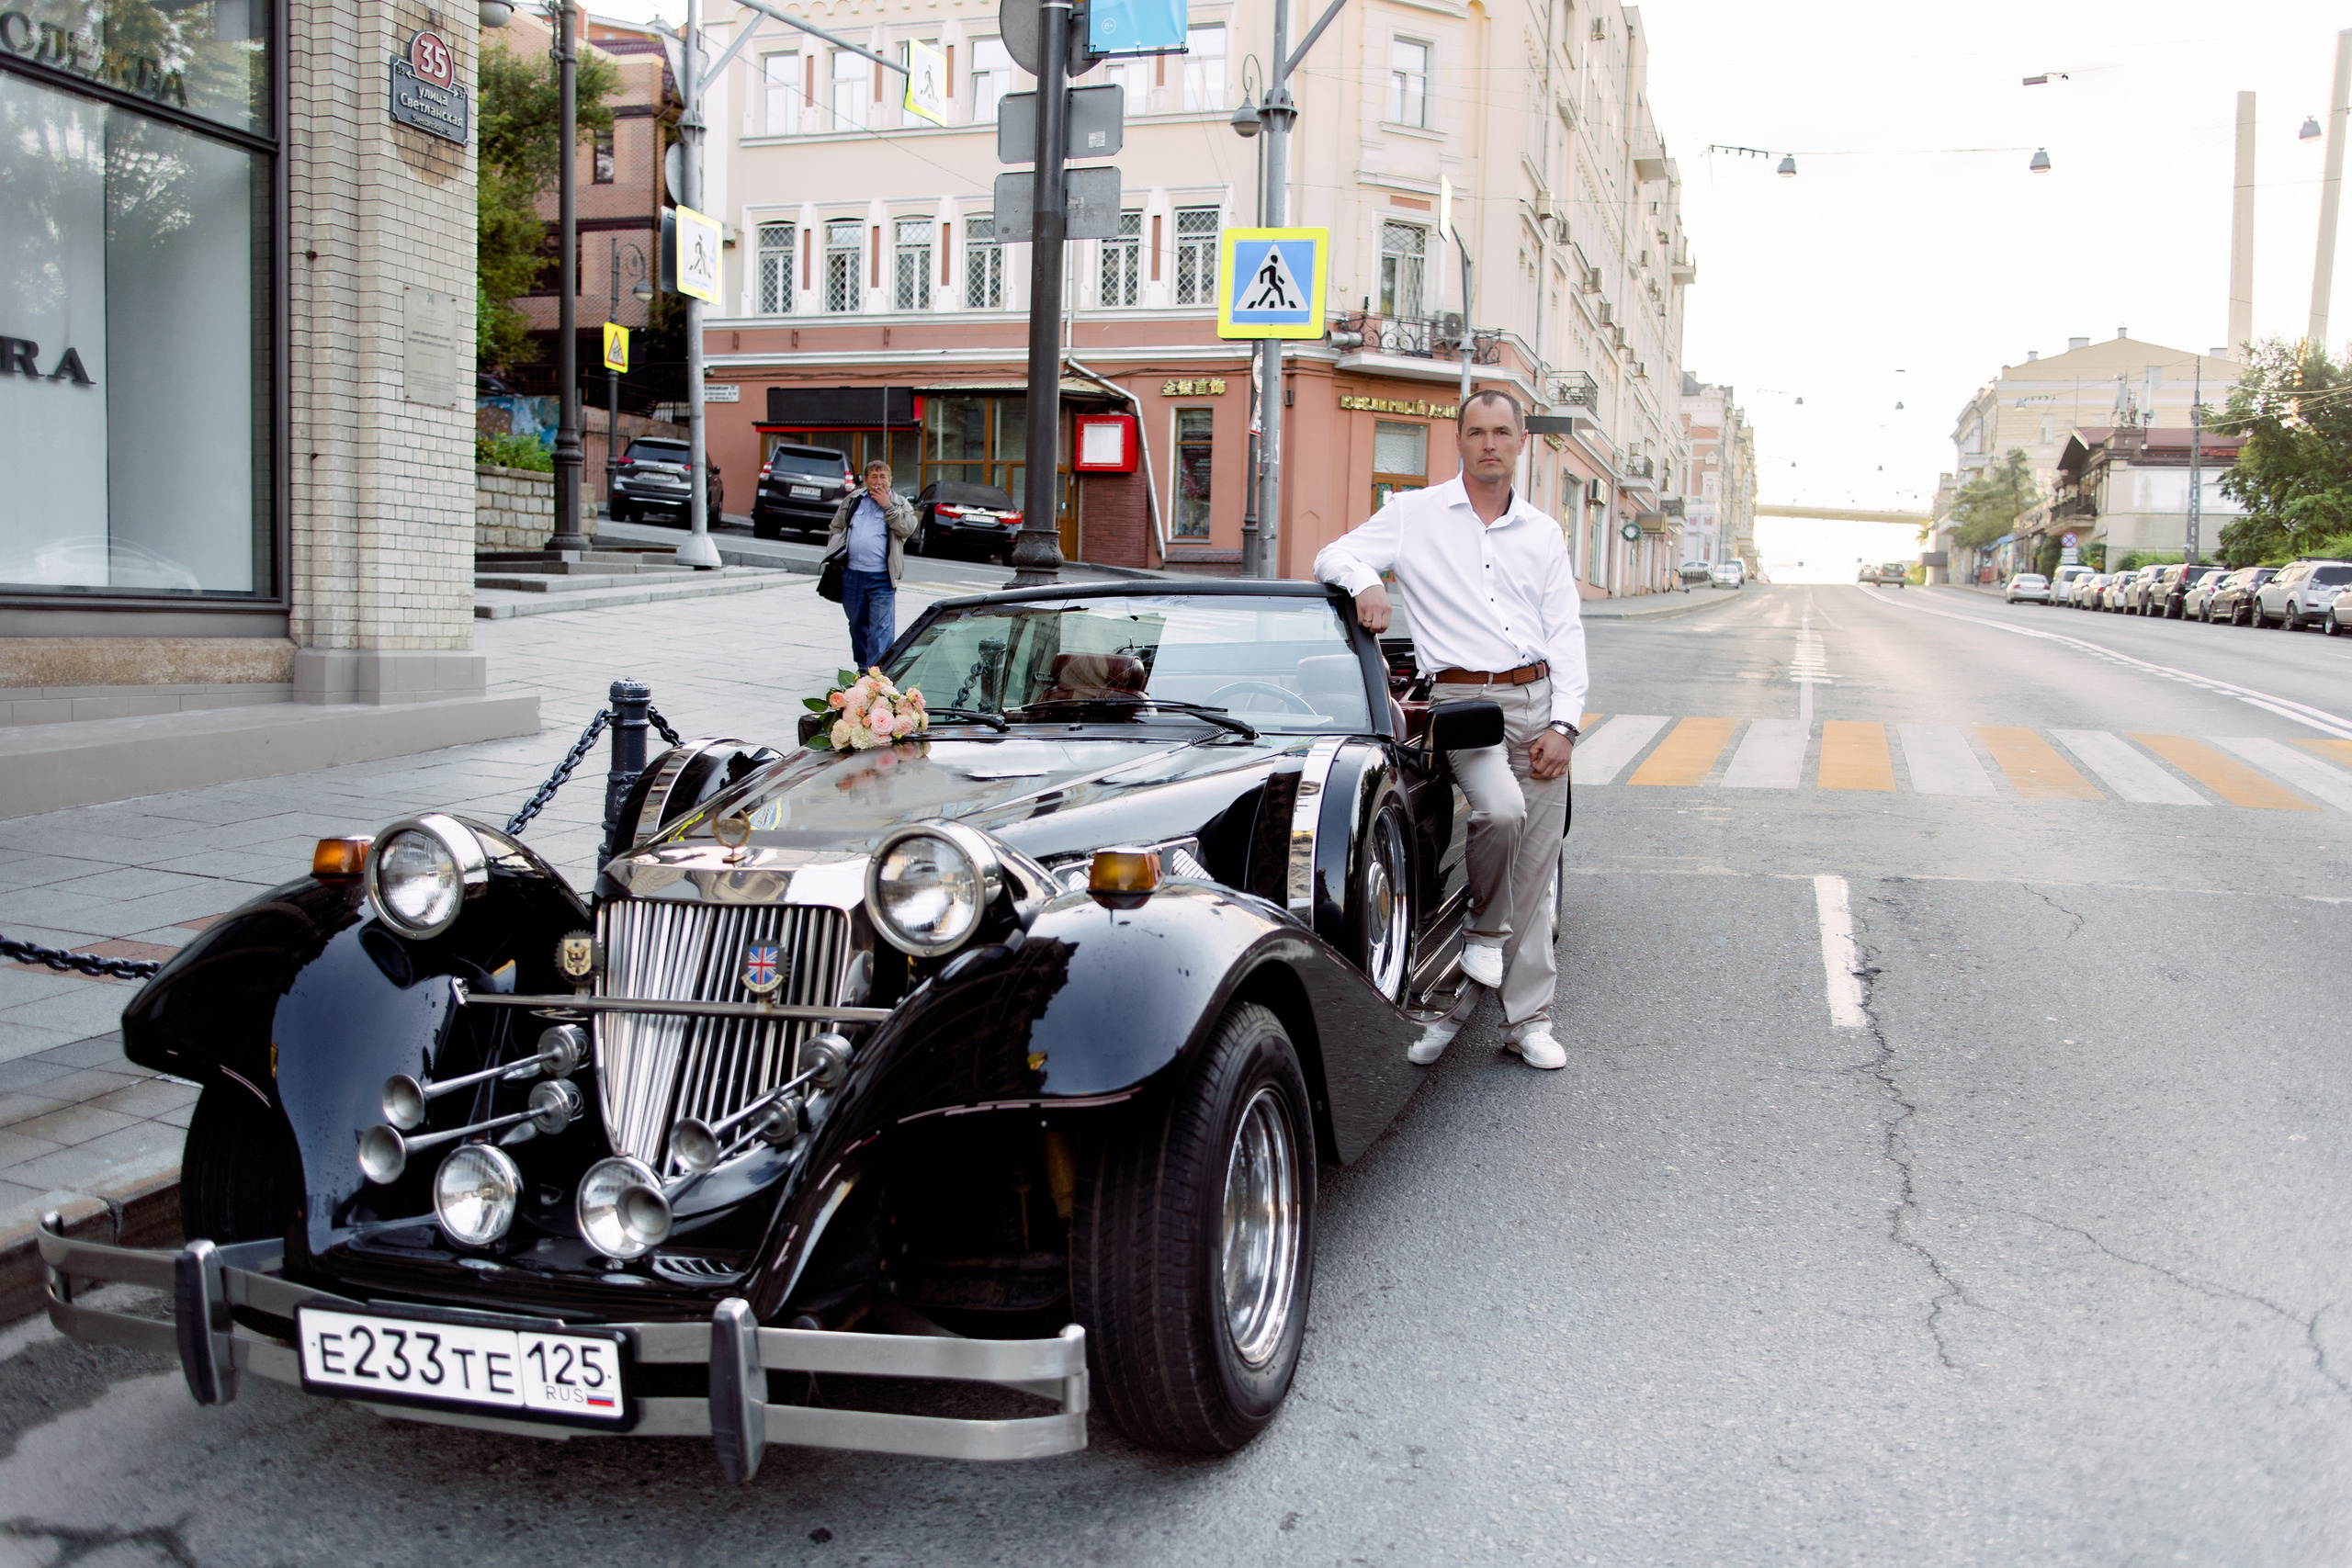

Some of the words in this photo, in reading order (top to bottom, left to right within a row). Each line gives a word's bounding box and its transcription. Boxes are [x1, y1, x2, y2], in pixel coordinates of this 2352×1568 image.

[1103, 22, 1114, 30] 6+
[420, 39, 447, 78] 35
[418, 85, 448, 107] улица
[400, 92, 464, 128] Светланская
[1340, 394, 1426, 415] ЮВЕЛИРНЫЙ
[319, 1325, 514, 1394] Е233ТЕ
[526, 1340, 605, 1388] 125
[545, 1384, 584, 1404] RUS
